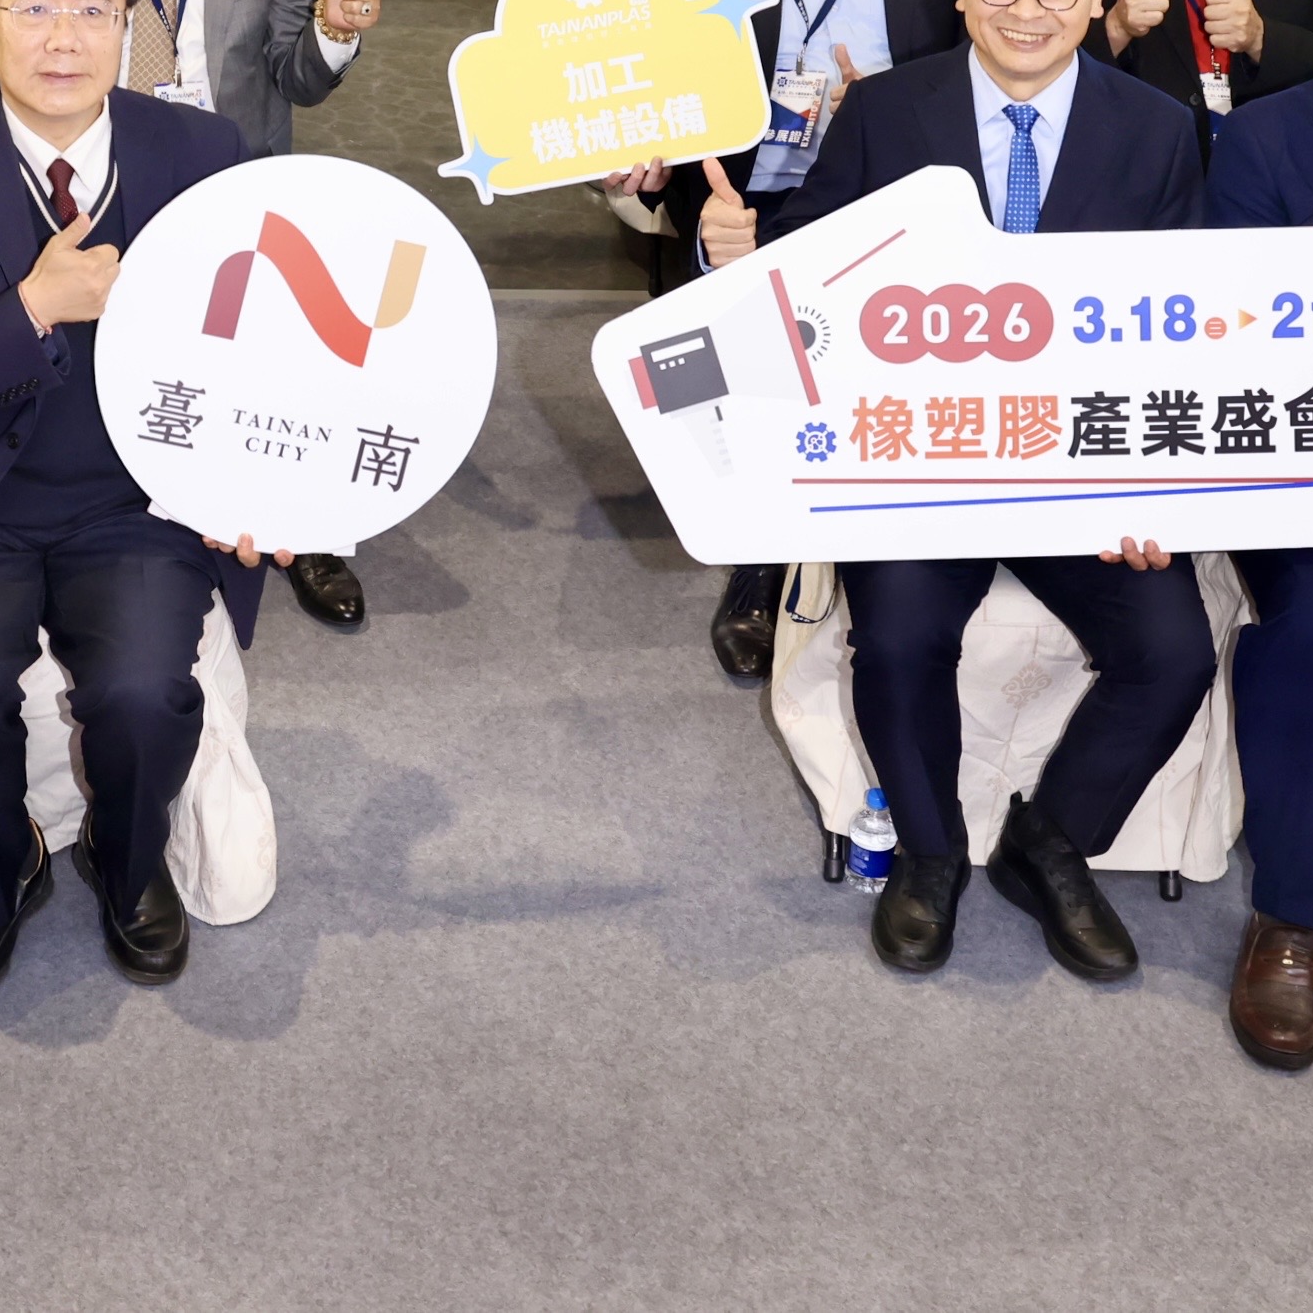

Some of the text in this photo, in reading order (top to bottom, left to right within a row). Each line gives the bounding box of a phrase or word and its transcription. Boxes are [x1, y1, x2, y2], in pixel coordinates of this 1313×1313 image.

[562, 52, 653, 104] 加工
[529, 92, 707, 165] 機械設備
[799, 100, 821, 148] EXHIBITOR
[882, 302, 1032, 345] 2026
[1072, 294, 1198, 344] 3.18
[1207, 320, 1225, 336] 三
[232, 408, 334, 444] TAINAN
[244, 436, 310, 463] CITY
